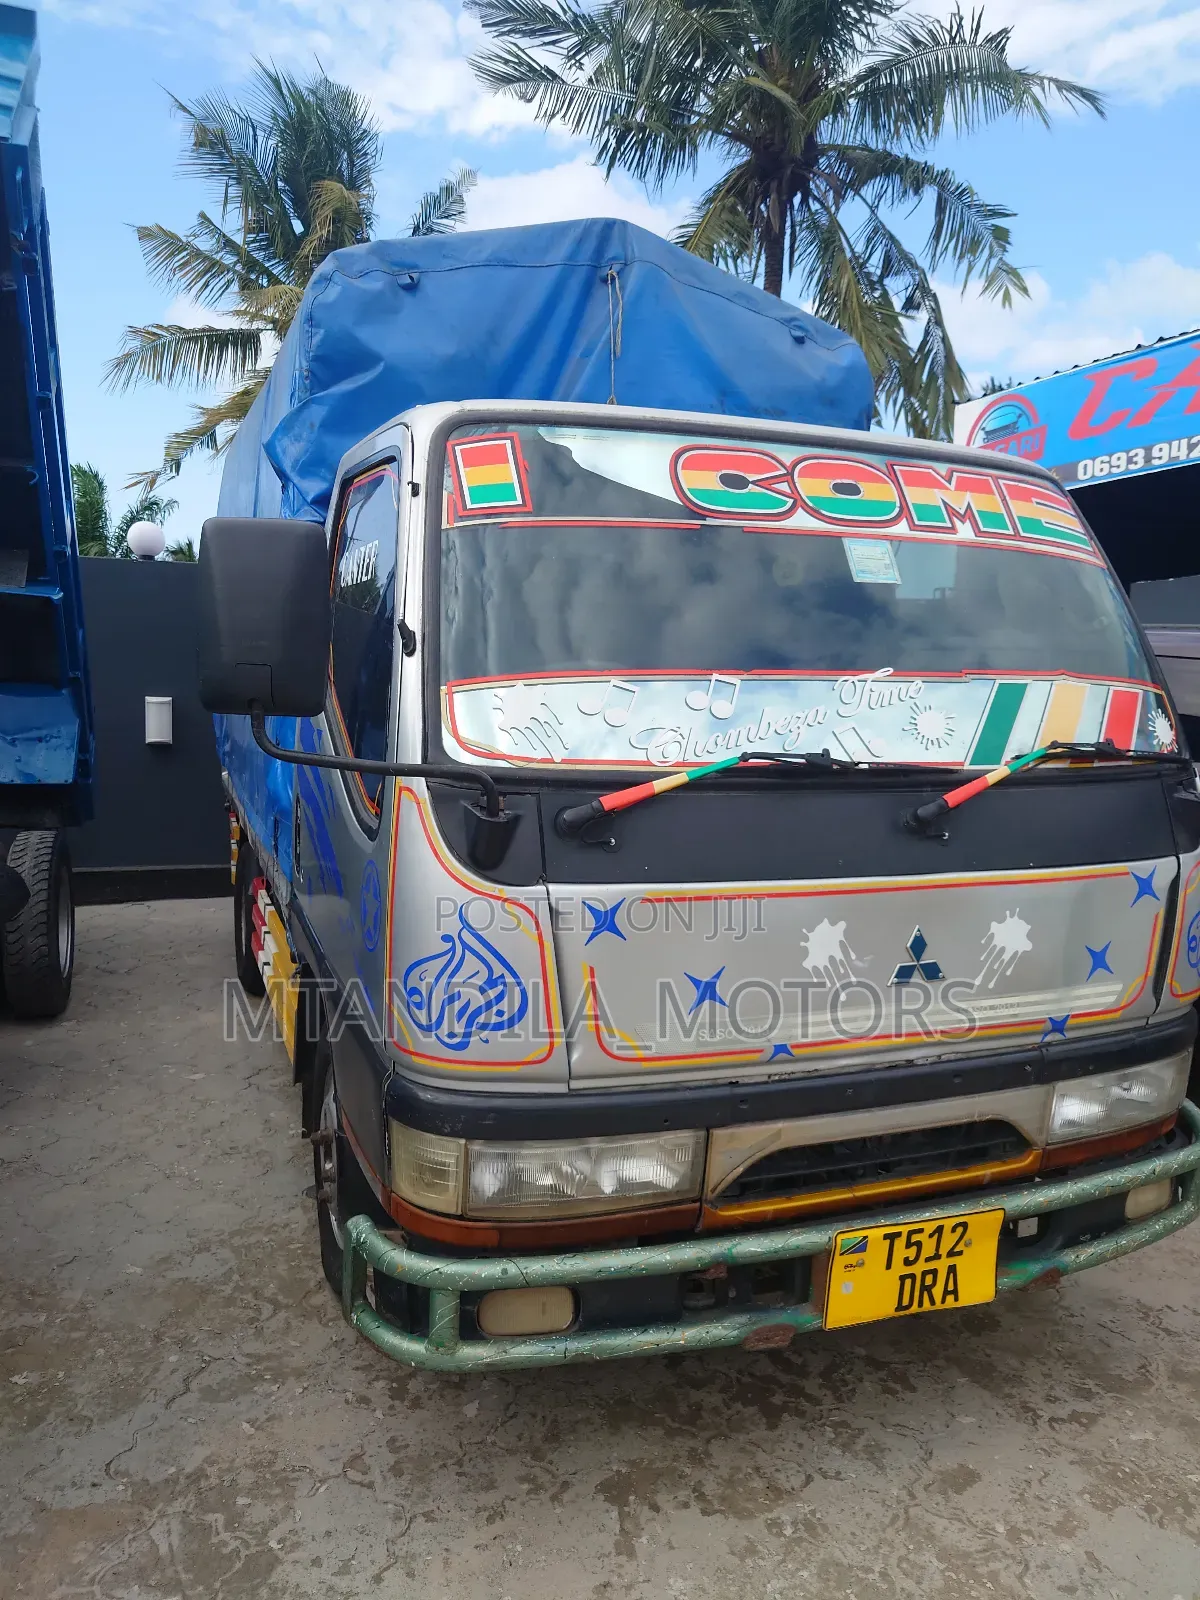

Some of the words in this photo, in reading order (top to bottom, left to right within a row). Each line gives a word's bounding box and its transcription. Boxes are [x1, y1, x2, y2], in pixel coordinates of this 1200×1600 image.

[1077, 447, 1145, 481] 0693
[670, 443, 1102, 560] COME
[342, 540, 379, 588] CANTER
[629, 706, 829, 767] Chombeza
[832, 667, 924, 718] Time
[883, 1221, 968, 1270] T512
[895, 1264, 959, 1312] DRA
